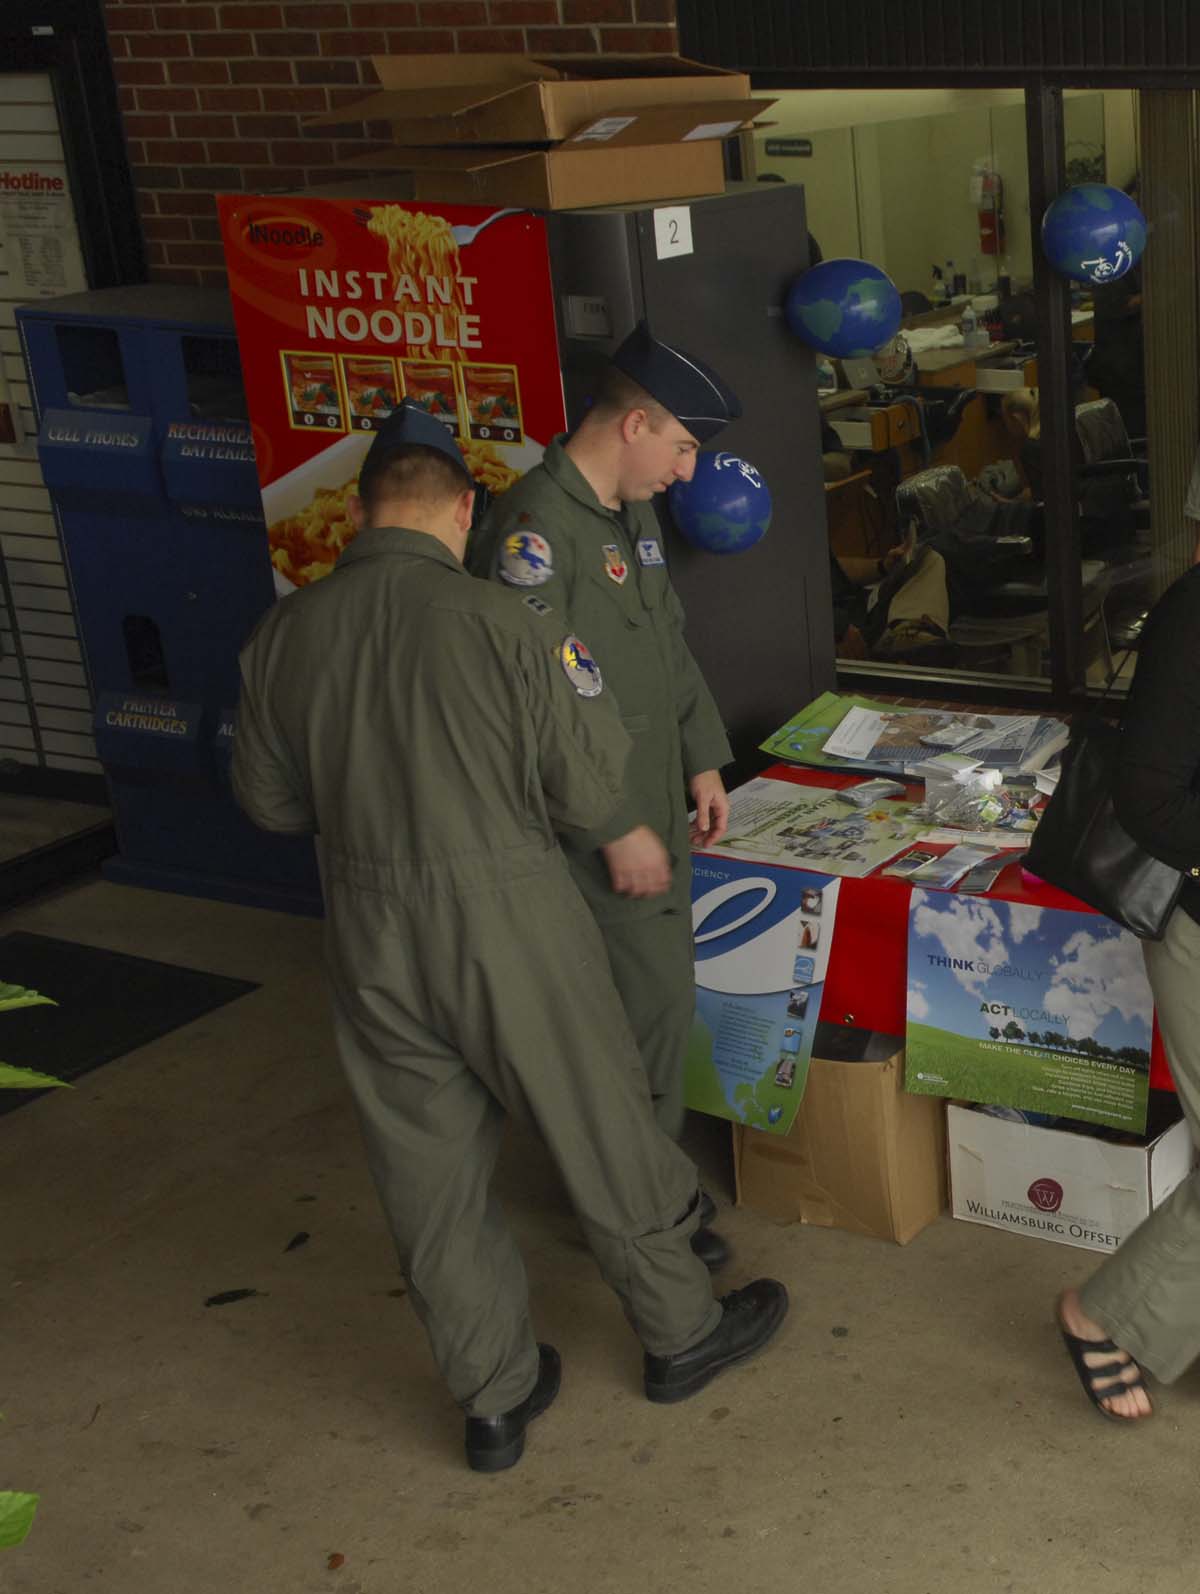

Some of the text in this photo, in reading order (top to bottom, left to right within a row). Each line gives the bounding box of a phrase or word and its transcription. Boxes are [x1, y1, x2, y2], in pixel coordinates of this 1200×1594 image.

[0, 171, 64, 190] Hotline
[668, 218, 679, 245] 2
[298, 268, 478, 306] INSTANT
[306, 305, 483, 350] NOODLE
[168, 421, 254, 446] RECHARGEA
[106, 711, 188, 735] CARTRIDGES
[928, 954, 1044, 982] THINK GLOBALLY
[980, 1002, 1071, 1026] ACT LOCALLY
[979, 1042, 1002, 1053] MAKE
[1004, 1046, 1021, 1055] THE
[1052, 1054, 1090, 1067] CHOICES
[1091, 1060, 1118, 1072] EVERY
[1119, 1064, 1136, 1076] DAY
[966, 1199, 1065, 1234] WILLIAMSBURG
[1068, 1223, 1121, 1247] OFFSET
